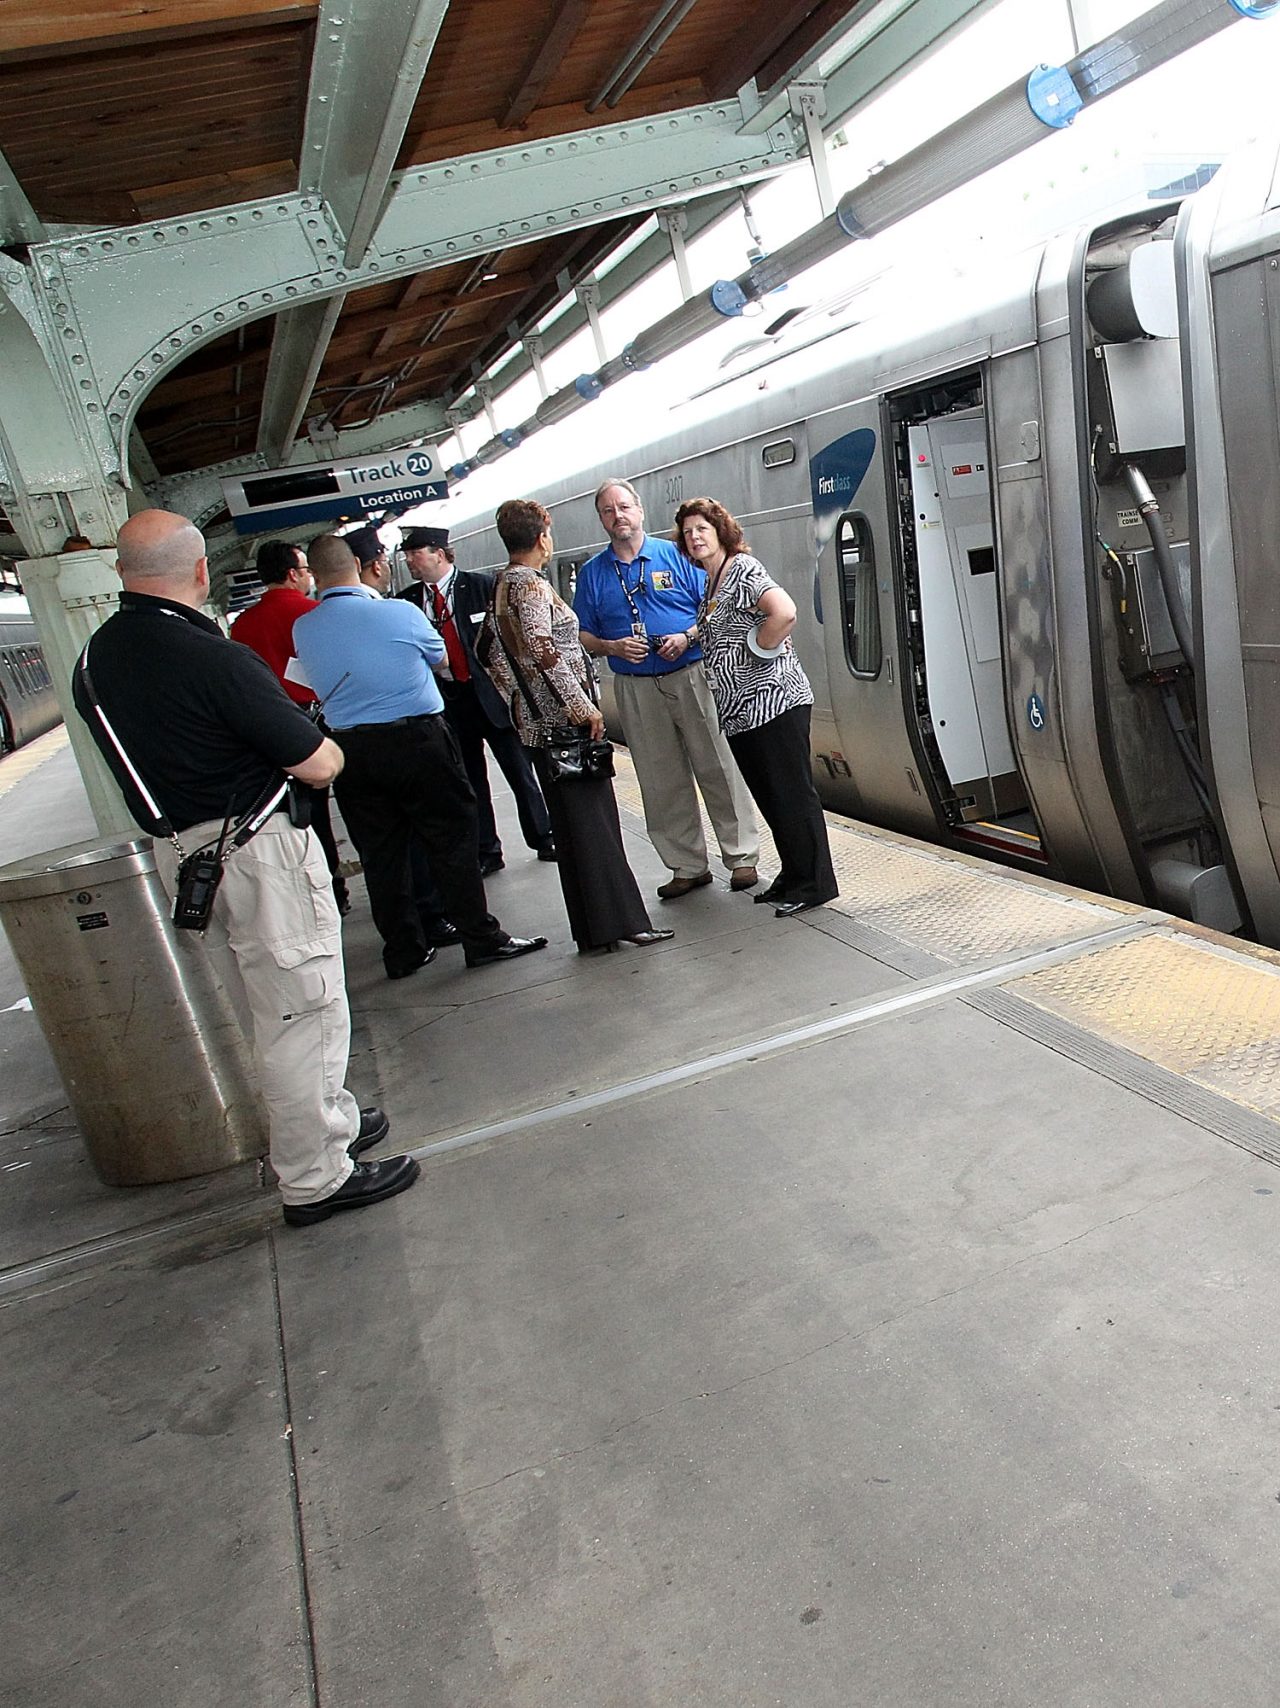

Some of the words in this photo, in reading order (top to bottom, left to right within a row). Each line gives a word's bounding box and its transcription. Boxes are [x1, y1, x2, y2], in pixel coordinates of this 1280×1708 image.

[345, 460, 405, 484] Track
[408, 456, 430, 473] 20
[359, 489, 422, 508] Location
[426, 485, 437, 496] A
[665, 475, 684, 504] 3207
